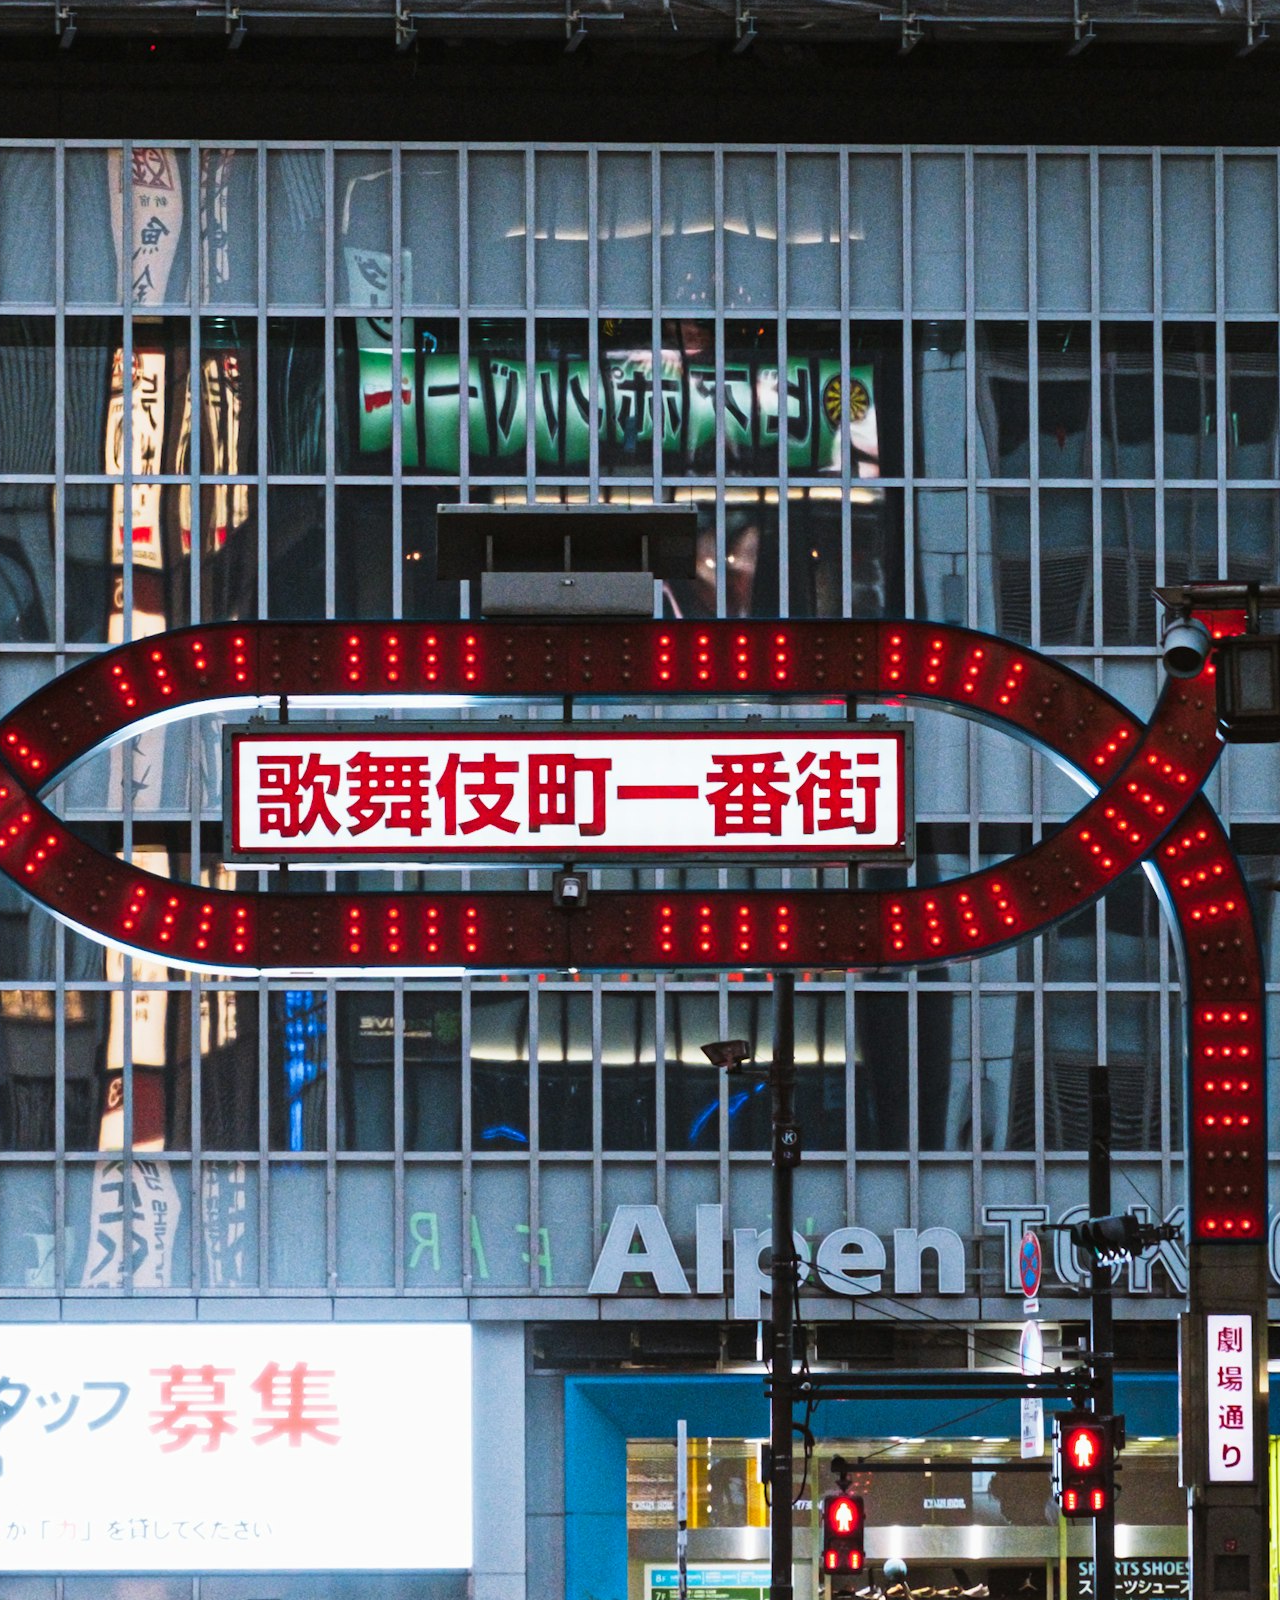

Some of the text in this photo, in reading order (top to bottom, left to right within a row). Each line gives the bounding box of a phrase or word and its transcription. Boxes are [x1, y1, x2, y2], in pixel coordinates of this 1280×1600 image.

[256, 751, 881, 838] 歌舞伎町一番街
[586, 1203, 967, 1320] Alpen
[1217, 1325, 1247, 1469] 劇場通り
